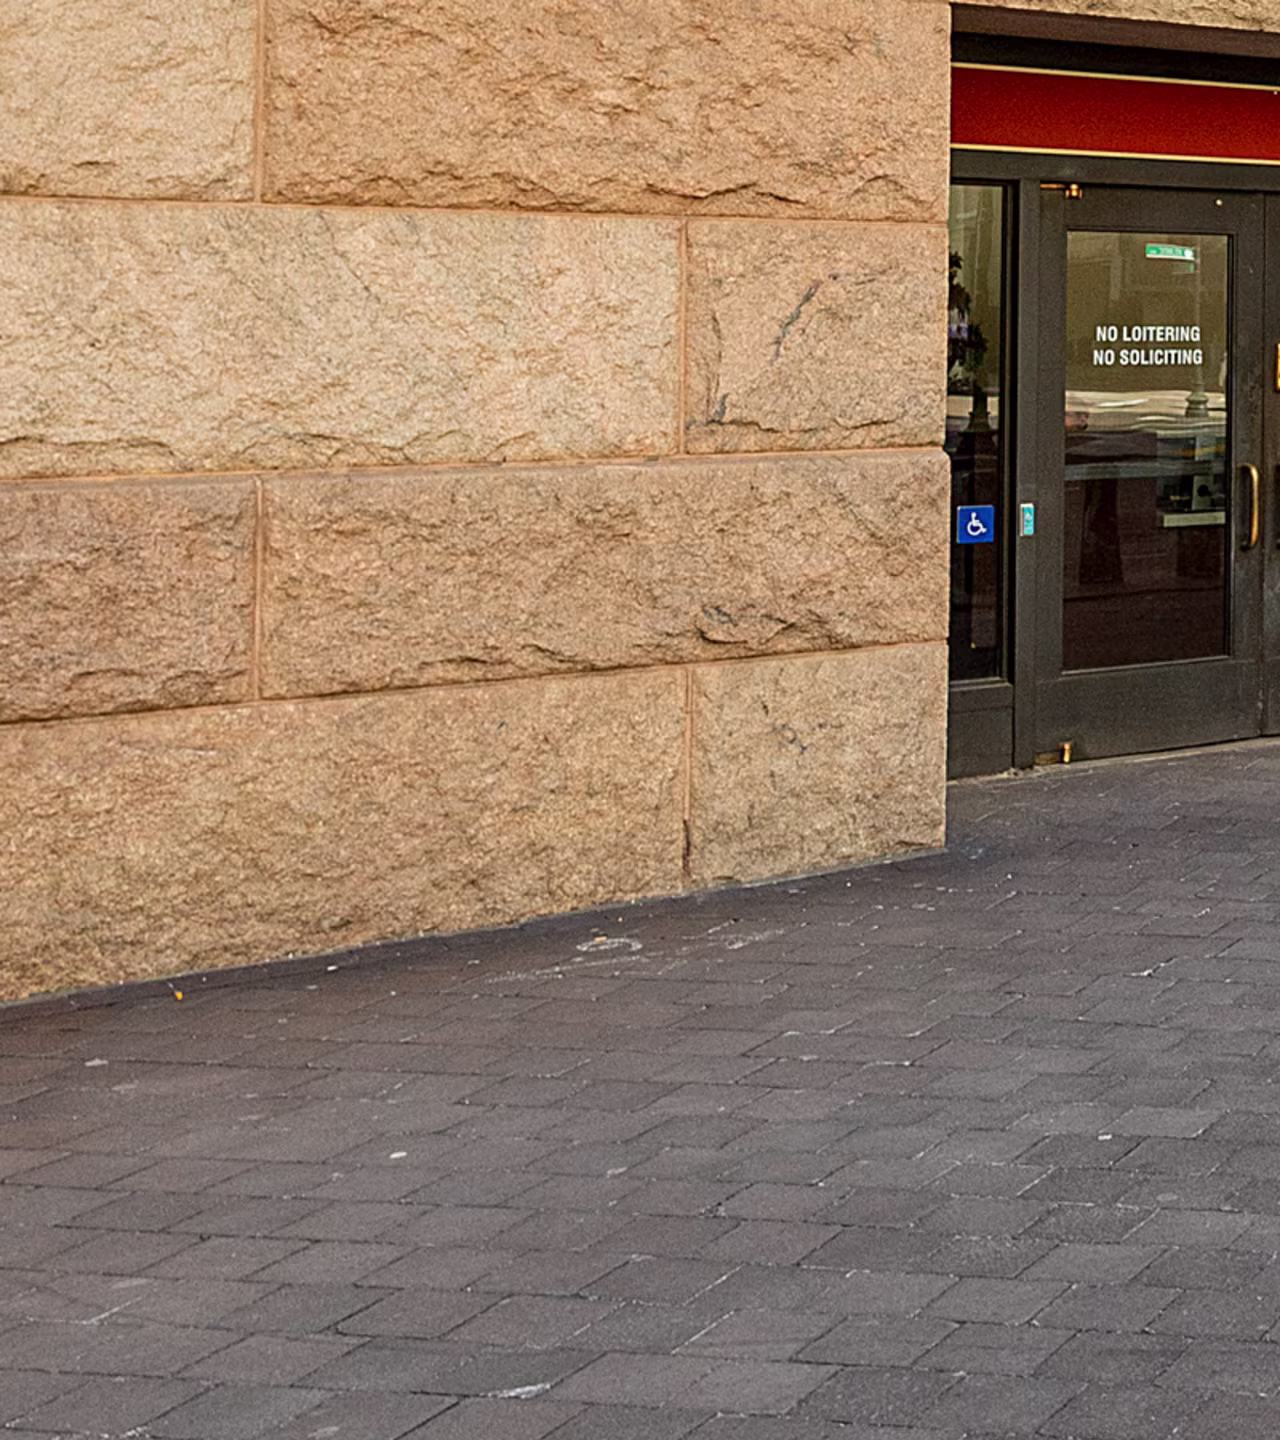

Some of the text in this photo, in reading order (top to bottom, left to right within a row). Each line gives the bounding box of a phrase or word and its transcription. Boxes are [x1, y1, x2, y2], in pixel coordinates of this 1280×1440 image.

[1096, 326, 1201, 342] NO LOITERING
[1093, 349, 1203, 365] NO SOLICITING
